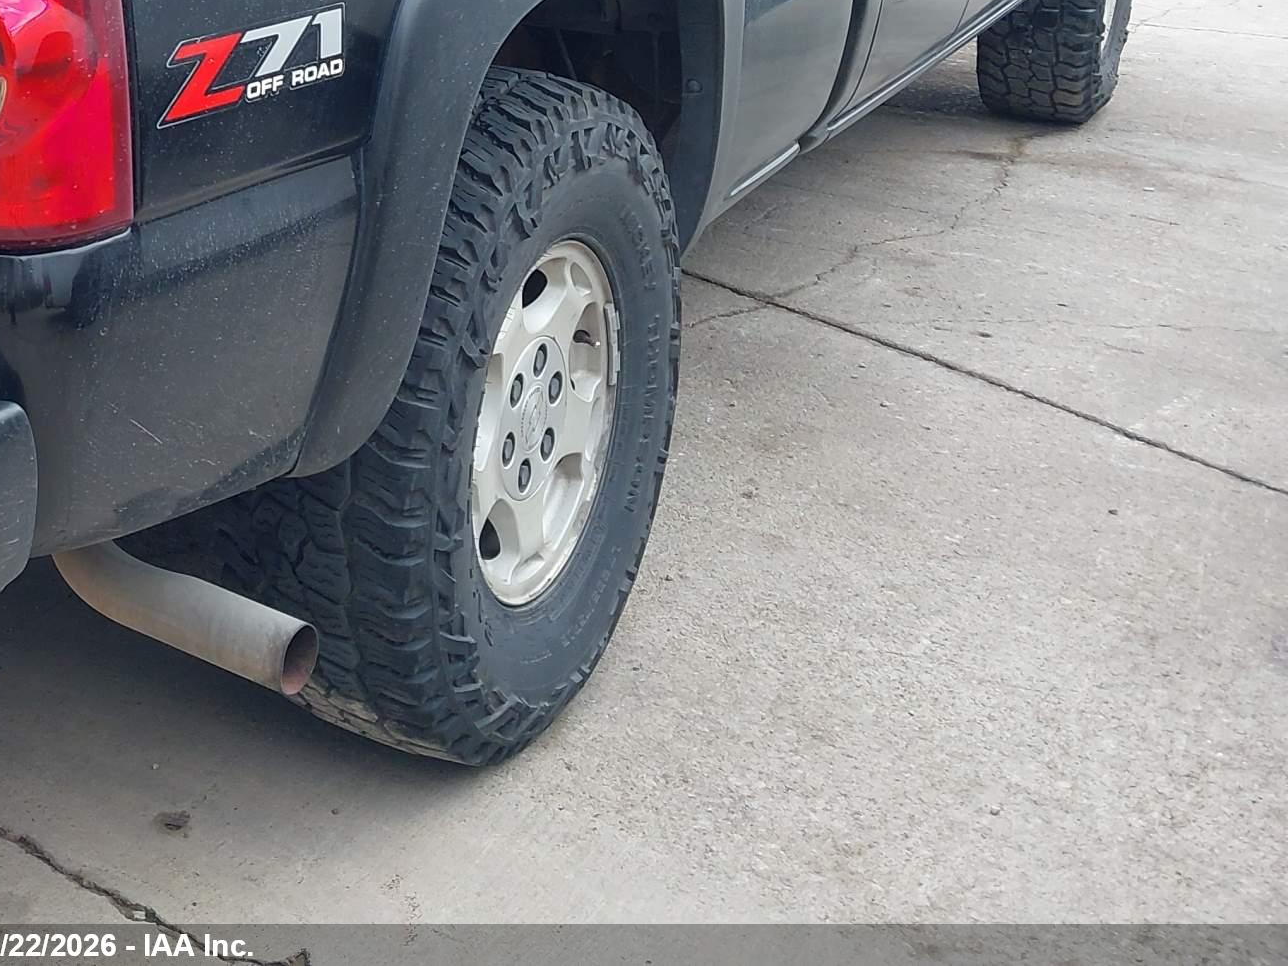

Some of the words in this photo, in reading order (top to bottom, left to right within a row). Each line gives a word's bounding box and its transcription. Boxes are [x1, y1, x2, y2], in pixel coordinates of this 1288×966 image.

[160, 8, 343, 124] Z71
[245, 74, 285, 100] OFF
[291, 58, 344, 87] ROAD
